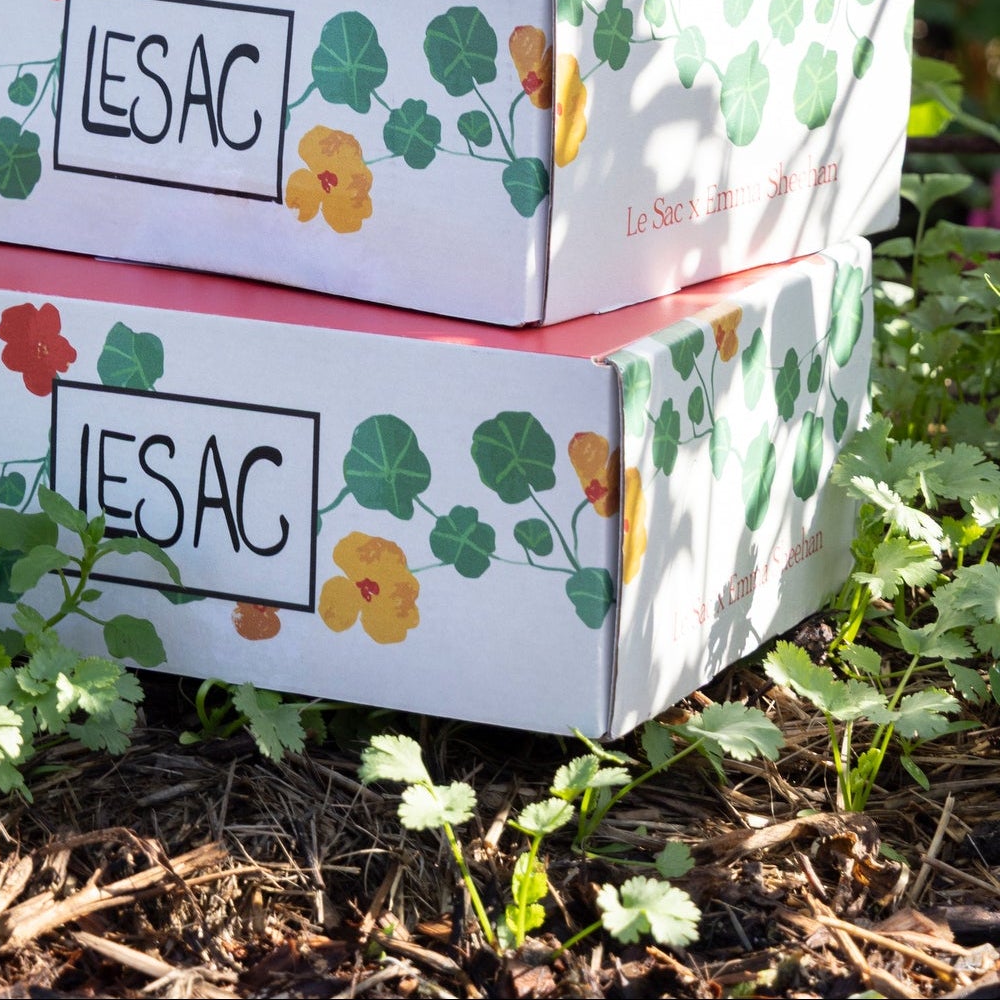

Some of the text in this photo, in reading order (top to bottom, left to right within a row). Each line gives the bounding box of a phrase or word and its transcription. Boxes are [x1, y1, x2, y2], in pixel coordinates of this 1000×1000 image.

[626, 206, 648, 237] Le
[652, 196, 684, 230] Sac
[688, 198, 701, 220] x
[706, 183, 761, 216] Emma
[771, 526, 824, 574] Seehan
